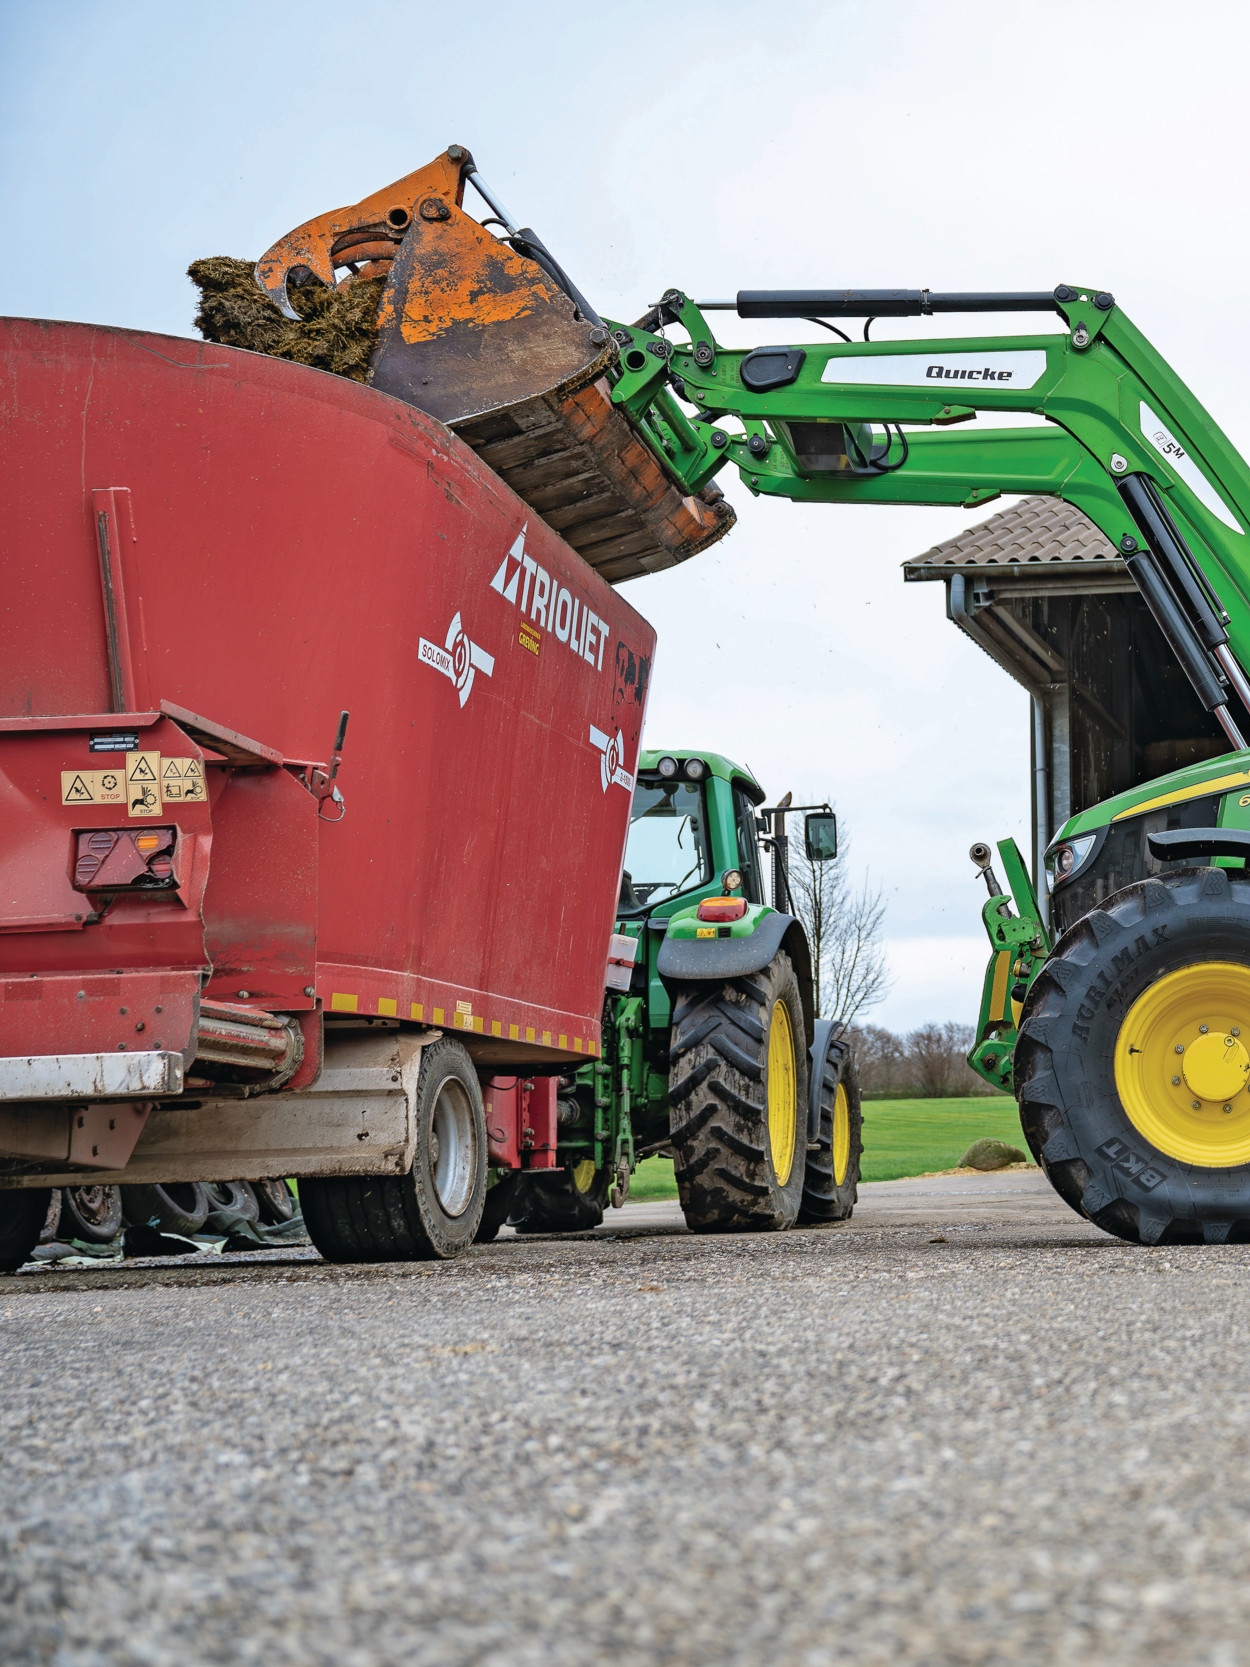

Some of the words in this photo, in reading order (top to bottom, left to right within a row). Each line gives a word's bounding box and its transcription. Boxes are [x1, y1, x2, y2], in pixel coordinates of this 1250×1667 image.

[926, 366, 1012, 381] Quicke
[520, 552, 610, 672] TRIOLIET
[421, 643, 451, 673] SOLOMIX
[100, 793, 121, 801] STOP
[1100, 1142, 1164, 1189] BKT
